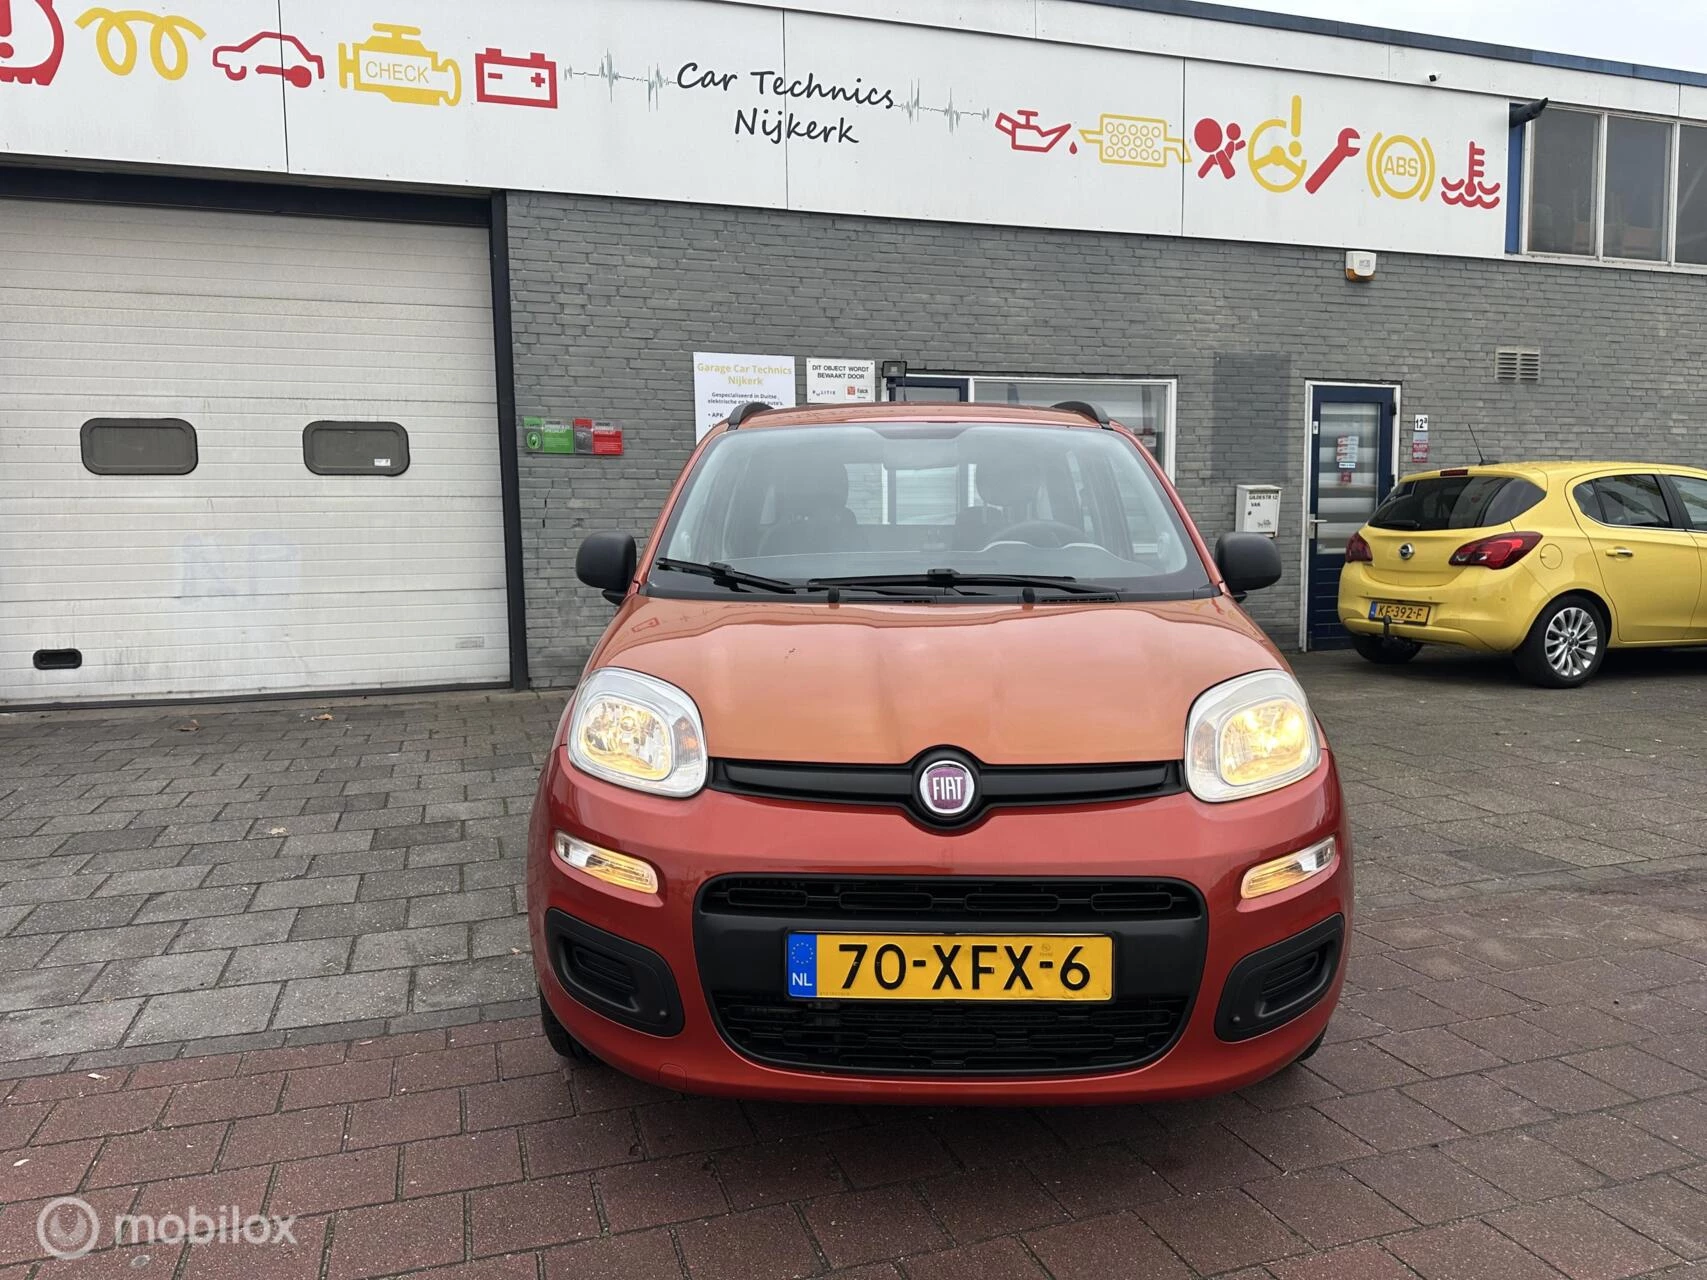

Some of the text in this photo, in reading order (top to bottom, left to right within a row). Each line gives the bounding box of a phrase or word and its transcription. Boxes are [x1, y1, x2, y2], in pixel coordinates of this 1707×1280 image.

[365, 60, 430, 85] CHECK
[675, 62, 895, 109] Car Technics
[734, 107, 860, 145] Nijkerk
[1384, 155, 1418, 178] ABS
[697, 363, 792, 375] Garage Car Technics
[728, 376, 763, 386] Nijkerk
[1378, 604, 1423, 620] KE-392-F
[932, 776, 964, 801] FIAT
[792, 943, 1091, 991] NL 70-XFX-6
